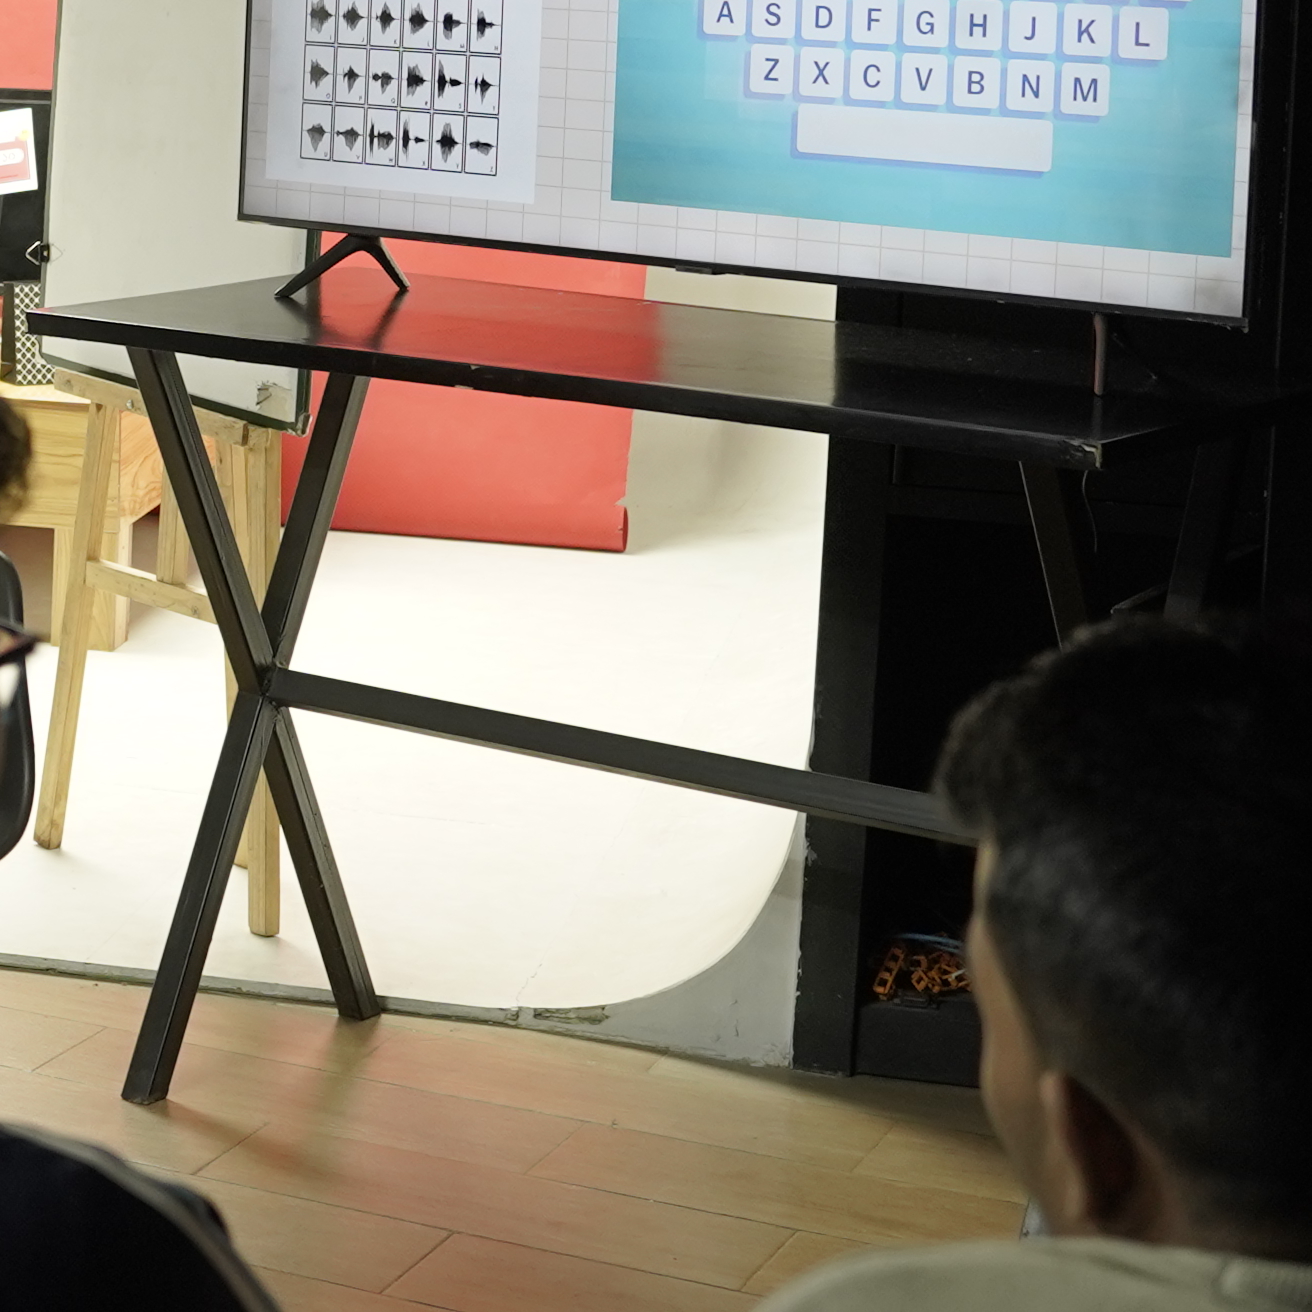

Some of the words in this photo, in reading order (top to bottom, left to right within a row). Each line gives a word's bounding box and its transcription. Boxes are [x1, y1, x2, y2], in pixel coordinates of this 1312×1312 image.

[716, 0, 735, 24] A
[764, 2, 781, 27] S
[814, 5, 833, 29] D
[867, 7, 882, 32] F
[916, 10, 935, 35] G
[968, 13, 988, 38] H
[1023, 16, 1037, 41] J
[1077, 18, 1096, 44] K
[1134, 21, 1151, 47] L
[763, 57, 780, 82] Z
[812, 60, 830, 85] X
[863, 64, 881, 89] C
[915, 67, 933, 92] V
[967, 70, 985, 95] B
[1021, 73, 1041, 99] N
[1072, 76, 1098, 103] M
